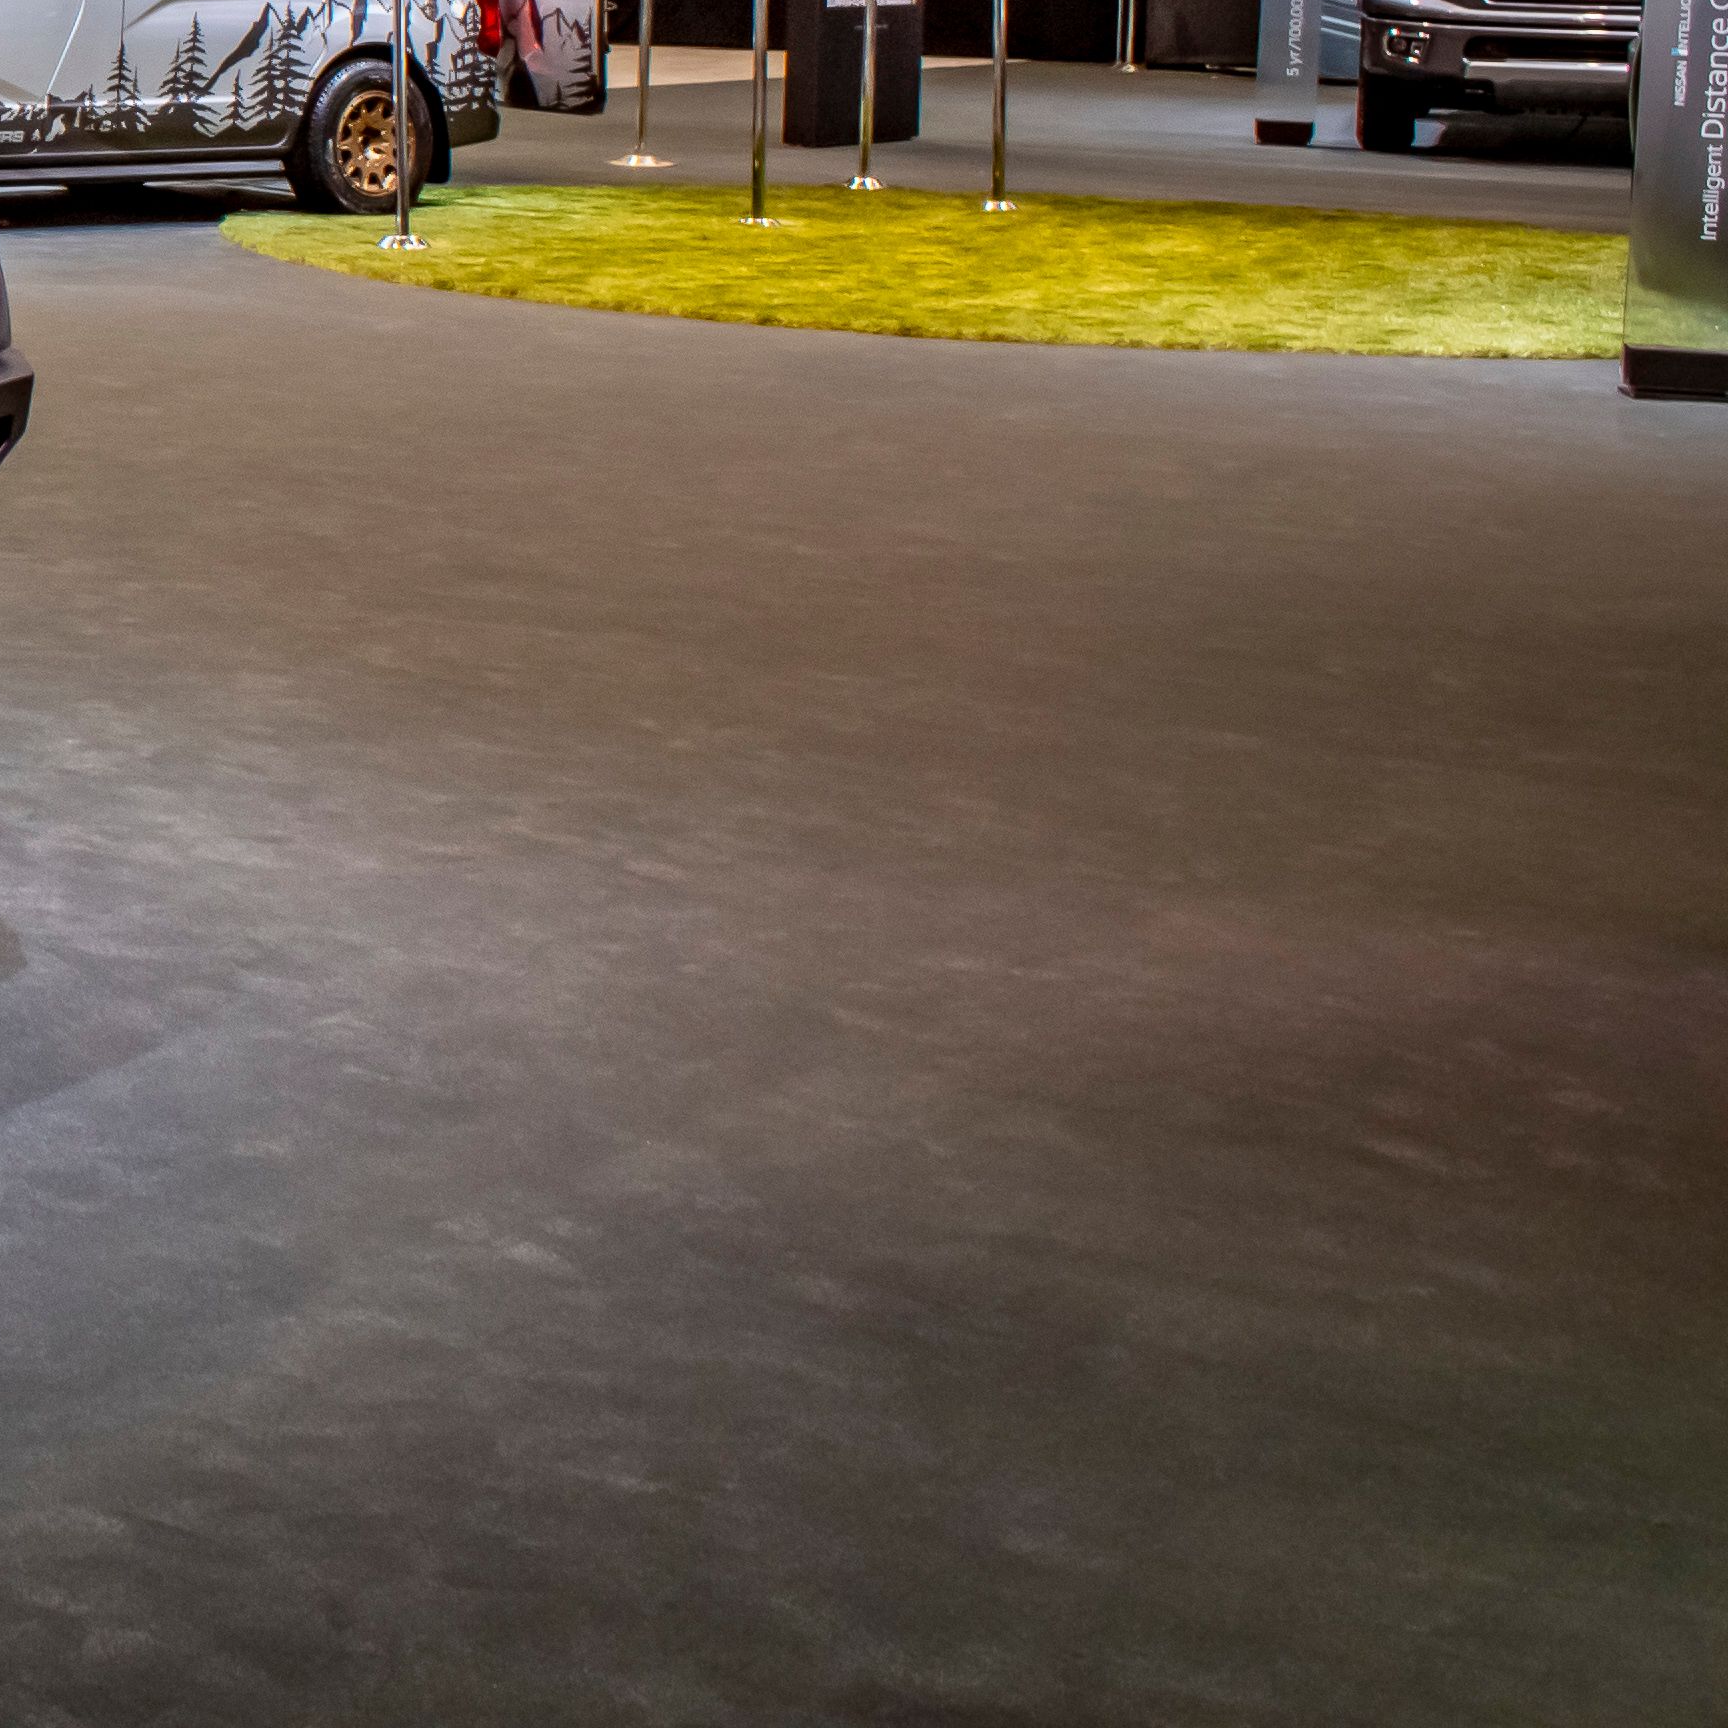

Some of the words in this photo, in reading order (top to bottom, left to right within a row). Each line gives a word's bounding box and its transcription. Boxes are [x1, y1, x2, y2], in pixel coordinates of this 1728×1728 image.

[1673, 60, 1688, 107] NISSAN
[1701, 17, 1728, 139] Distance
[1699, 144, 1726, 242] Intelligent
